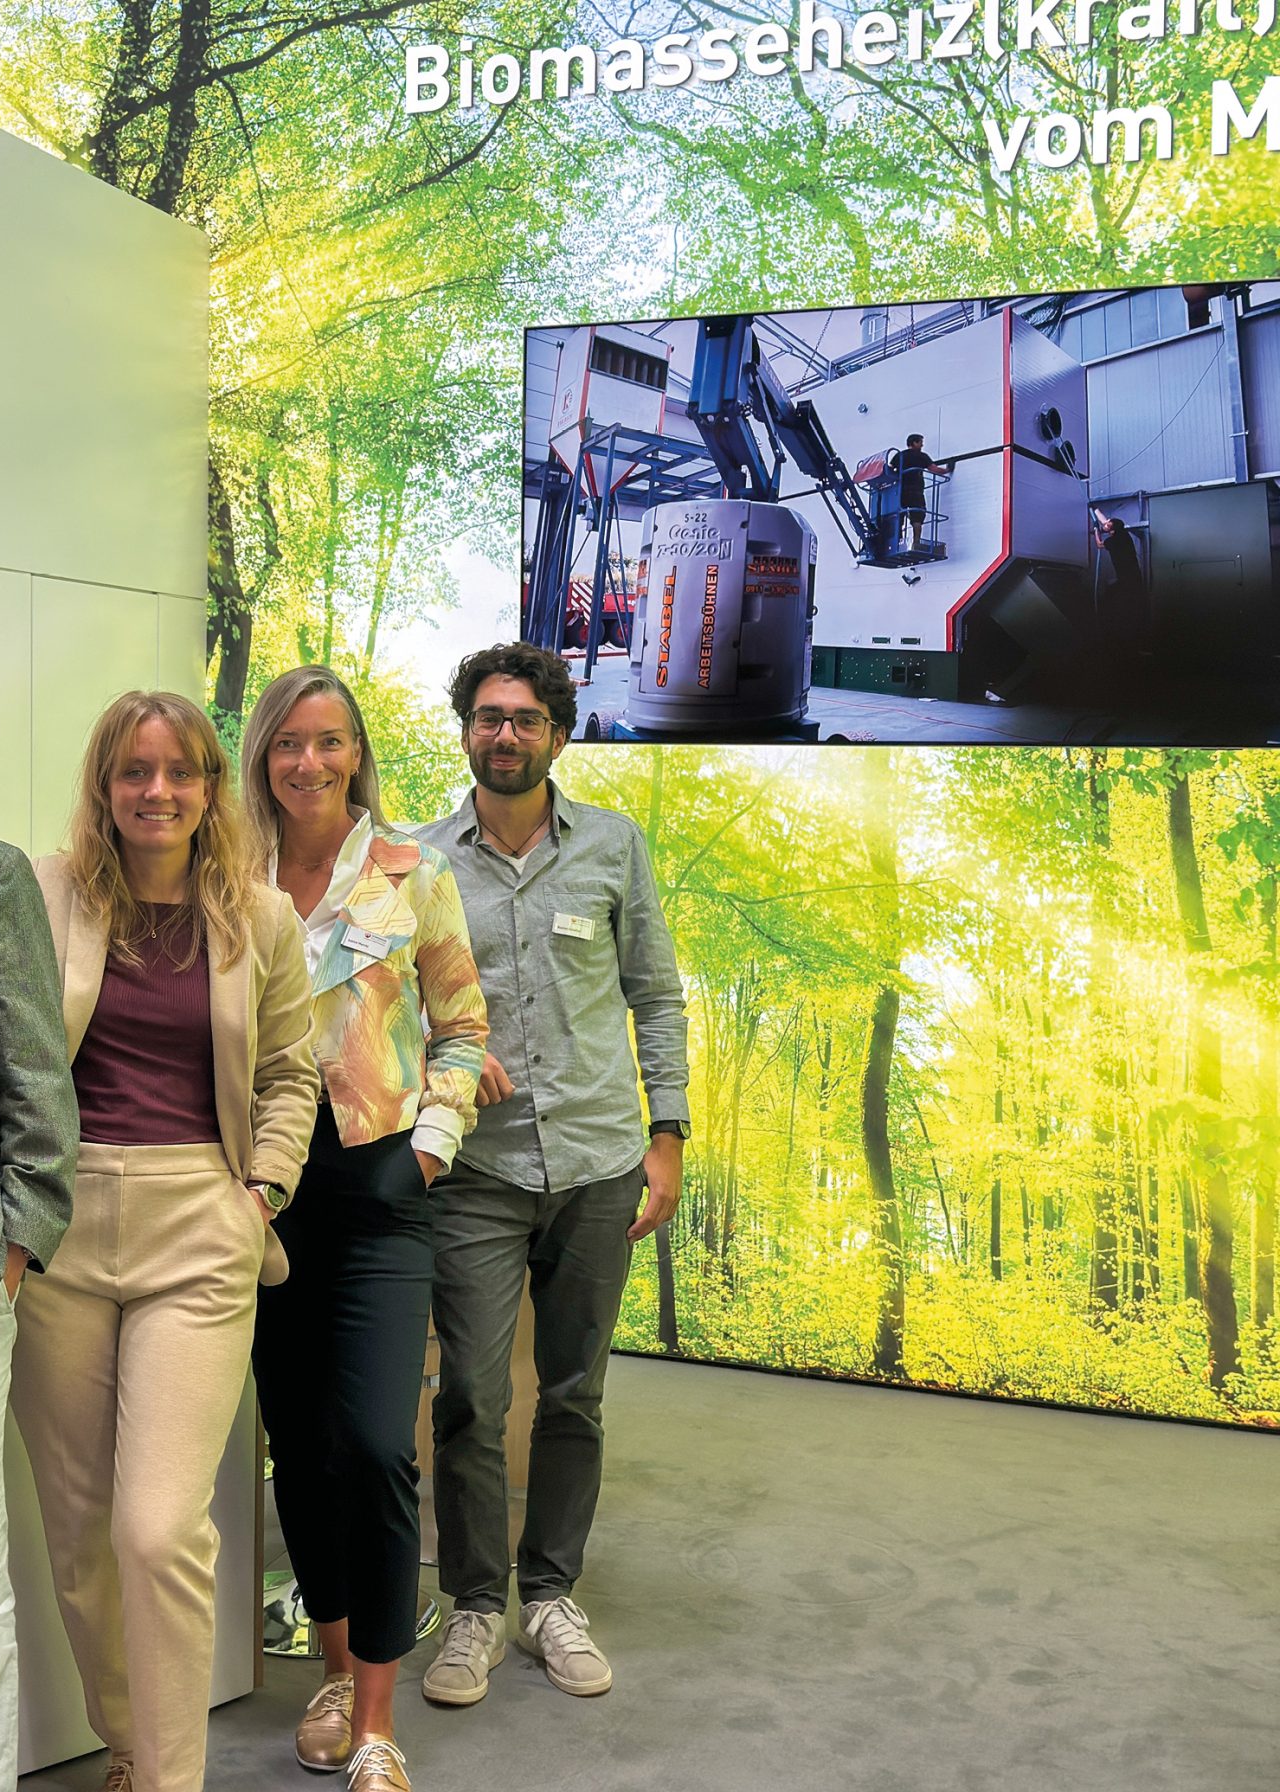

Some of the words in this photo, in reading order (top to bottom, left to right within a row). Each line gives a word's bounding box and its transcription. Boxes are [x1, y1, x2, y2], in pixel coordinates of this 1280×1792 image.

[982, 105, 1173, 172] vom
[656, 565, 677, 688] STABEL
[698, 564, 719, 689] ARBEITSBÜHNEN
